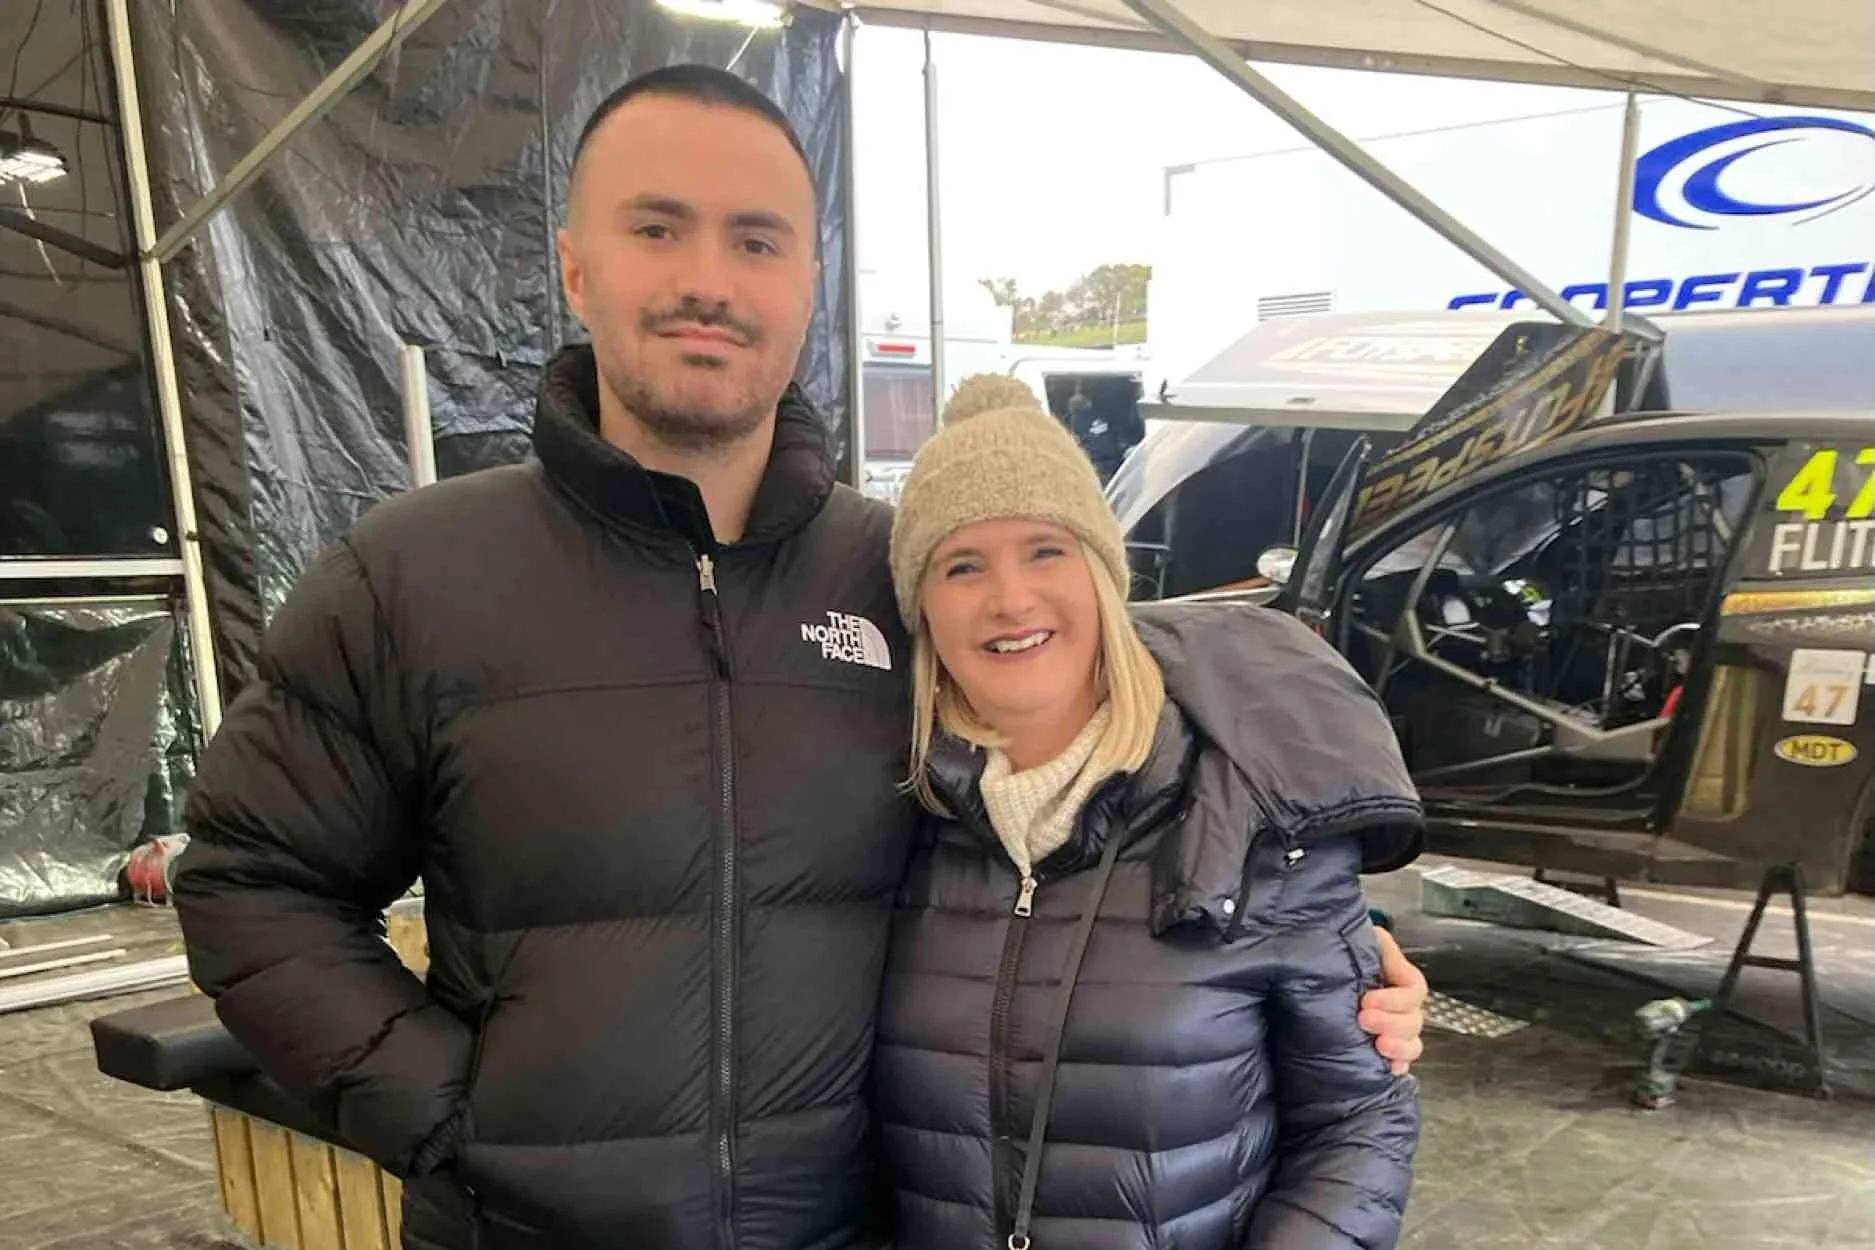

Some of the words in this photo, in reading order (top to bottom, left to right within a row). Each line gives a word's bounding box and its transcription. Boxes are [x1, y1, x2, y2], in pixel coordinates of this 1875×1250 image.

[1768, 521, 1875, 571] FLIT
[826, 611, 860, 631] THE
[801, 624, 861, 648] NORTH
[821, 641, 865, 664] FACE
[1791, 683, 1850, 718] 47
[1790, 740, 1842, 761] MDT
